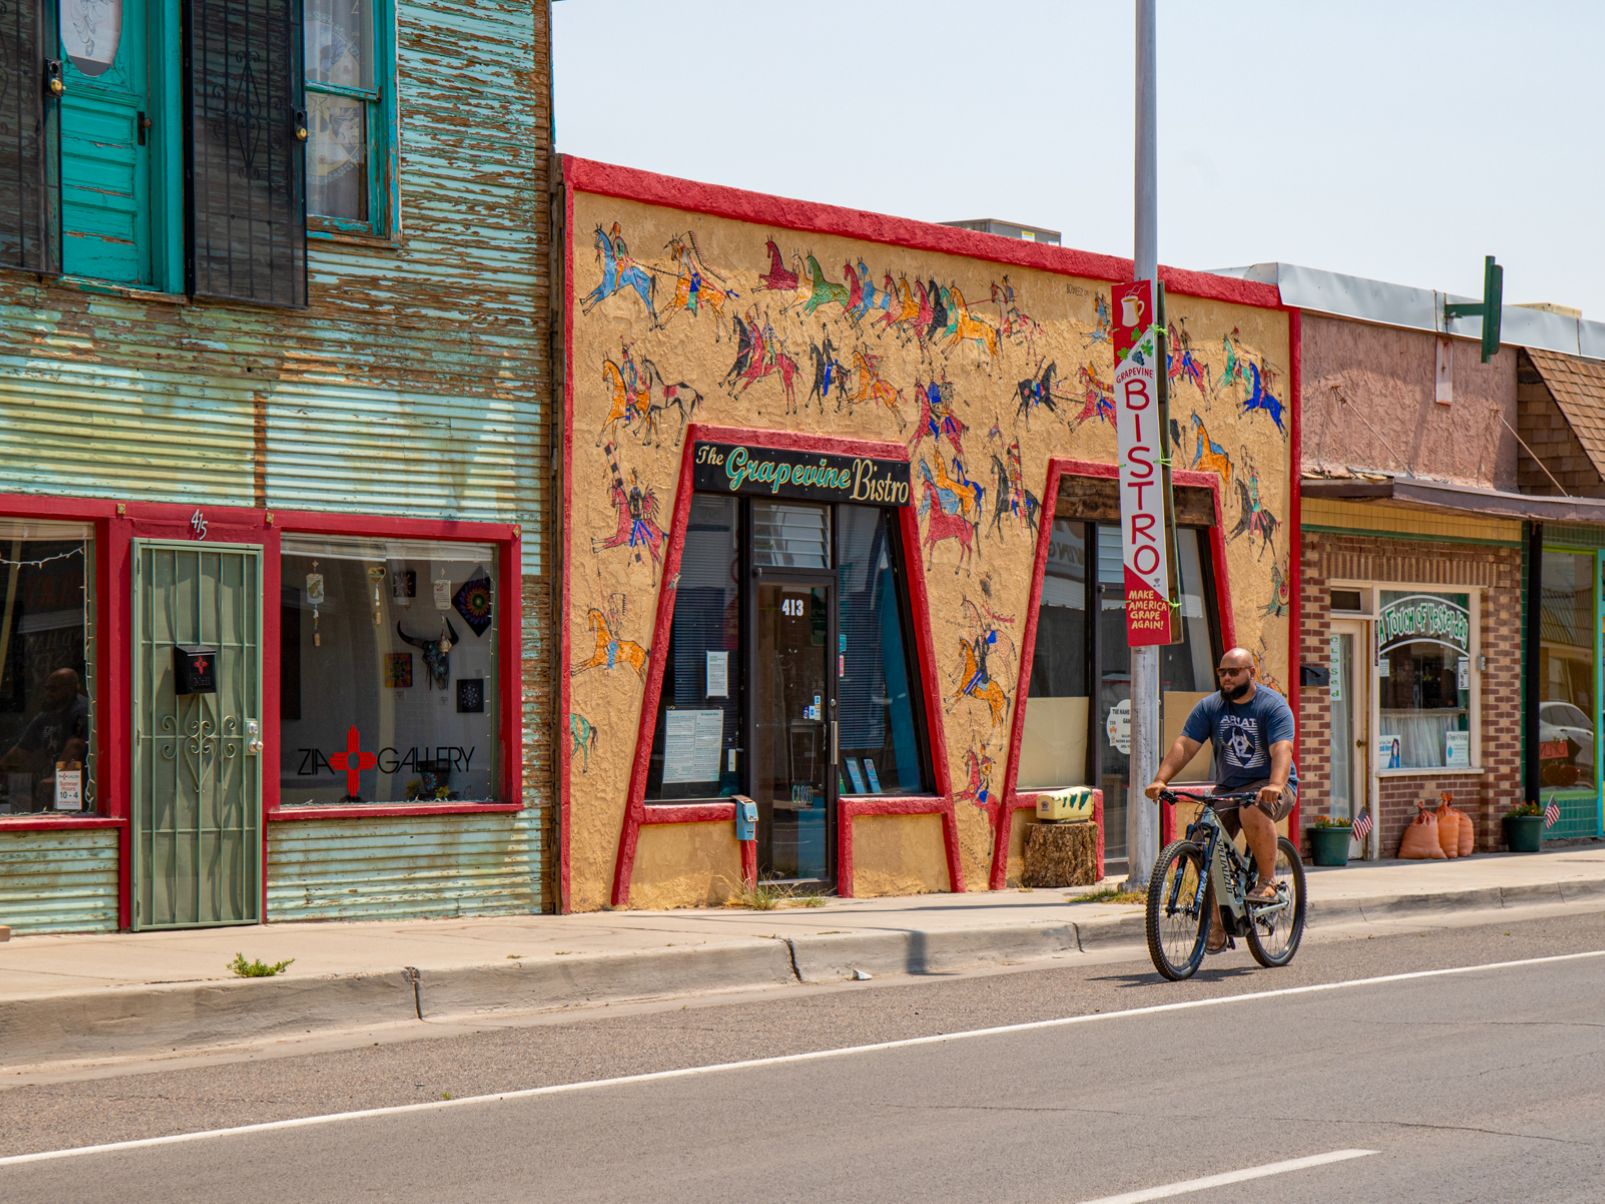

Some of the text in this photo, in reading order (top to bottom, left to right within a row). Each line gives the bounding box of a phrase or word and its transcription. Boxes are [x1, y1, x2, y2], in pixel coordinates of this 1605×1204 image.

[1116, 367, 1154, 384] GRAPEVINE
[695, 445, 909, 503] The Grapevine Bistro
[1124, 378, 1160, 576] BISTRO
[190, 508, 209, 540] 415
[1128, 590, 1155, 600] MAKE
[781, 598, 804, 617] 413
[1128, 600, 1167, 611] AMERICA
[1130, 610, 1160, 620] GRAPE
[1131, 619, 1164, 630] AGAIN!
[1220, 714, 1257, 728] ARIAT
[297, 746, 475, 776] ZIA GALLERY
